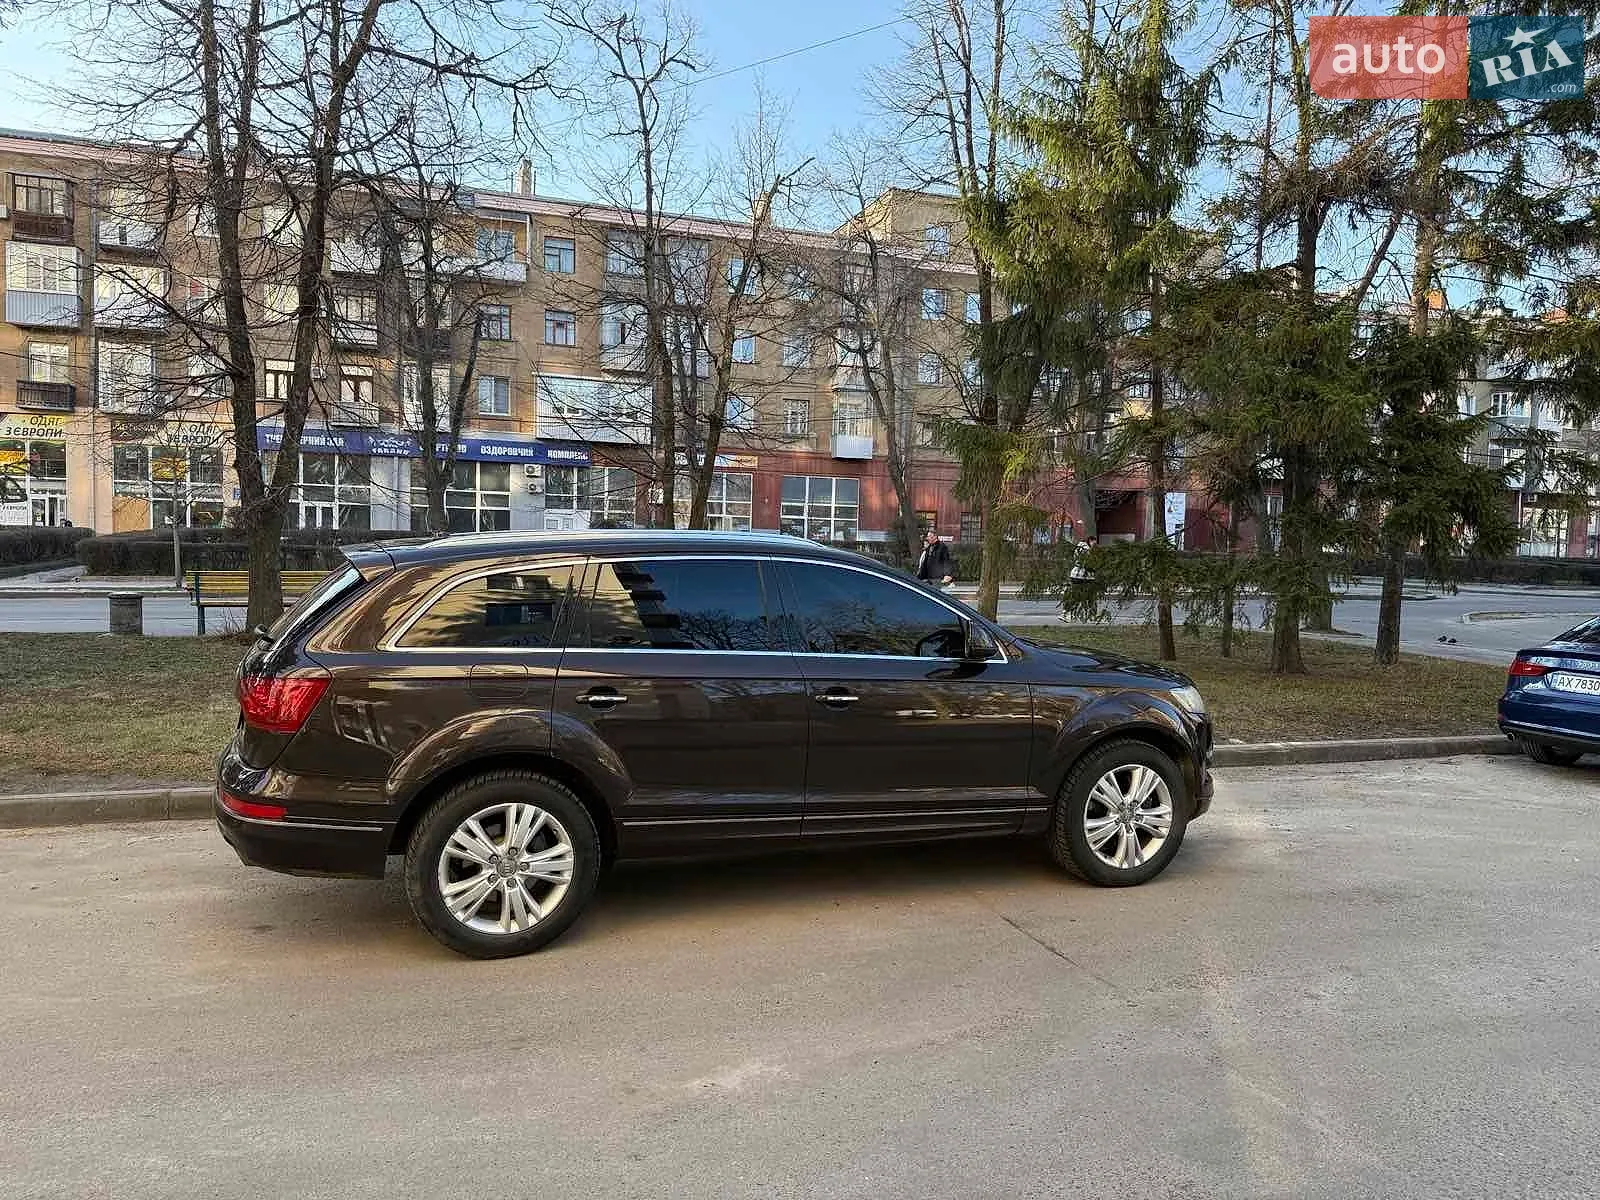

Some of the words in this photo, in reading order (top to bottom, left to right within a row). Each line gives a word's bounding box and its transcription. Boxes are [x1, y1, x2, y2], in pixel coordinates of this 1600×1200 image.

[30, 415, 63, 427] ОДЯГ
[1557, 676, 1573, 689] AX
[1574, 678, 1600, 691] 7830
